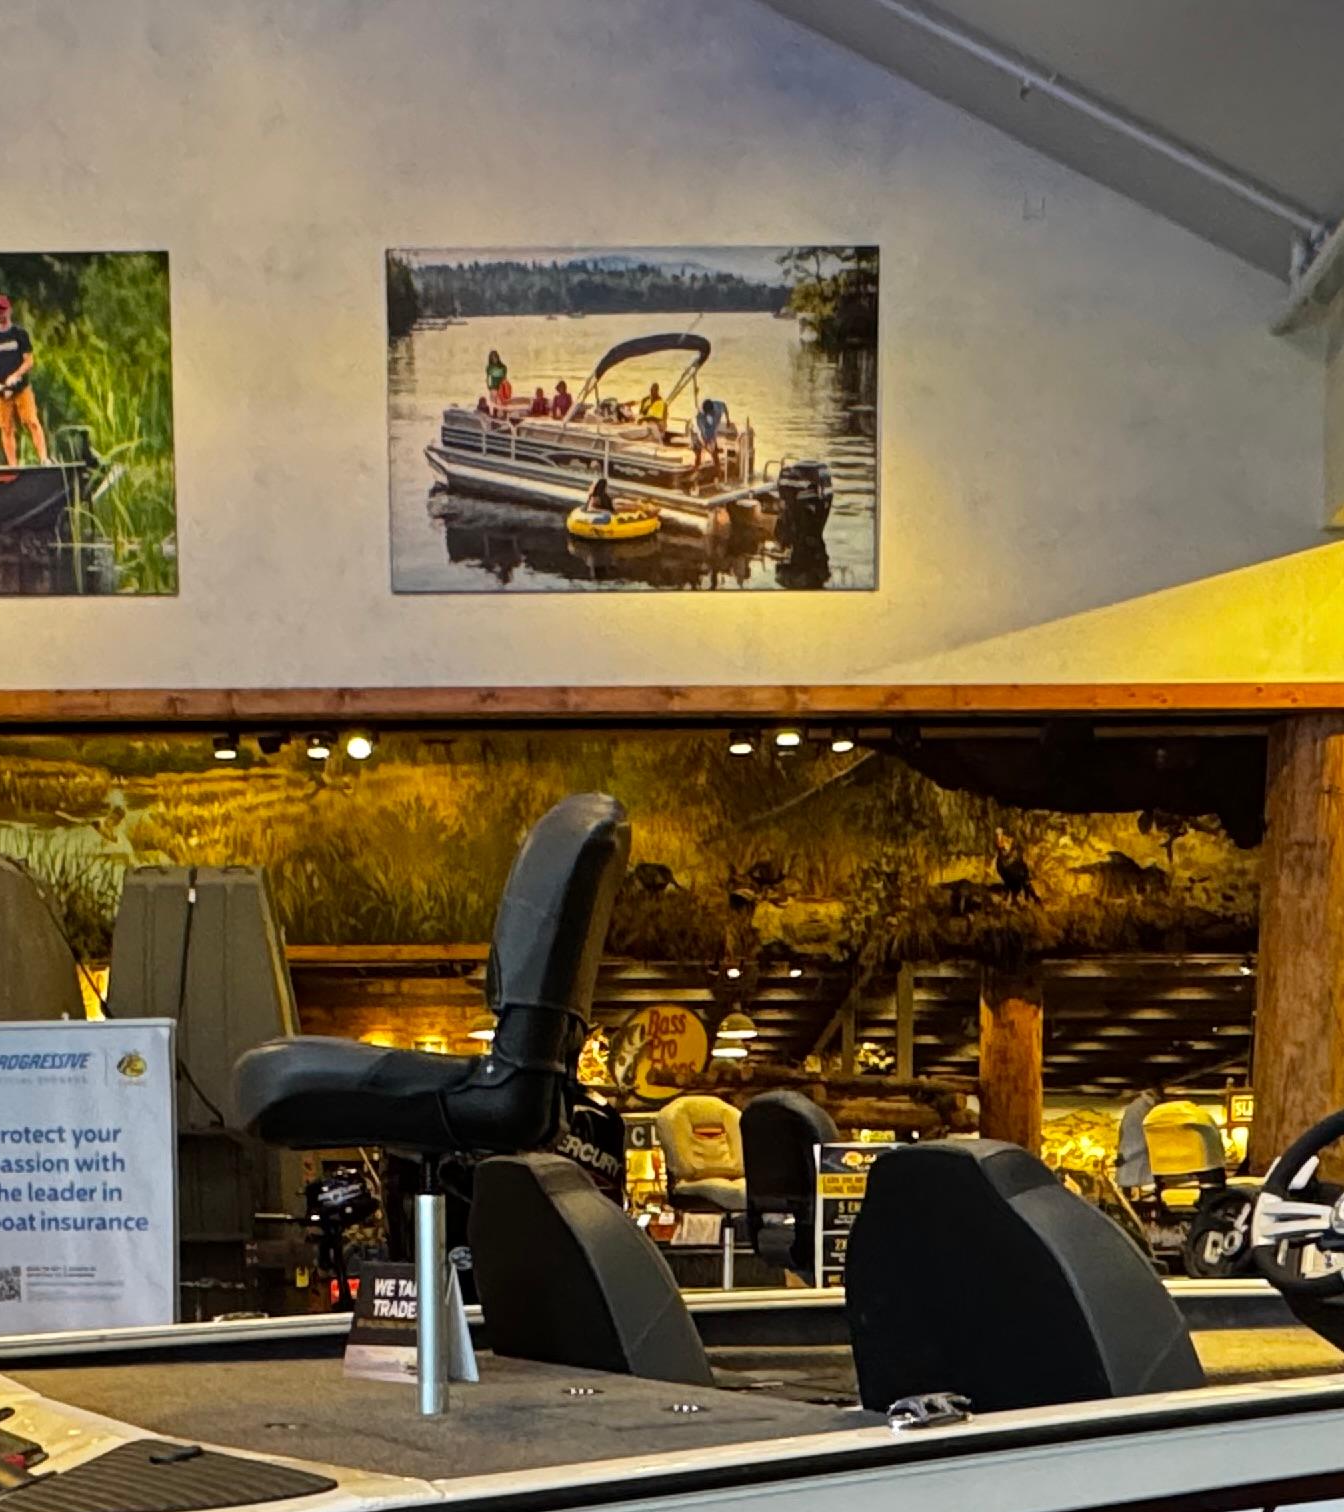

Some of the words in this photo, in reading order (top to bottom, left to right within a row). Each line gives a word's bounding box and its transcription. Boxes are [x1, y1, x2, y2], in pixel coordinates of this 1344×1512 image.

[648, 1010, 687, 1036] Bass
[649, 1037, 677, 1061] Pro
[71, 1128, 122, 1149] your
[74, 1151, 126, 1173] with
[556, 1134, 623, 1177] ERCURY
[28, 1181, 97, 1202] leader
[102, 1181, 122, 1202] in
[40, 1211, 150, 1232] insurance
[374, 1279, 396, 1297] WE
[373, 1299, 418, 1319] TRADE
